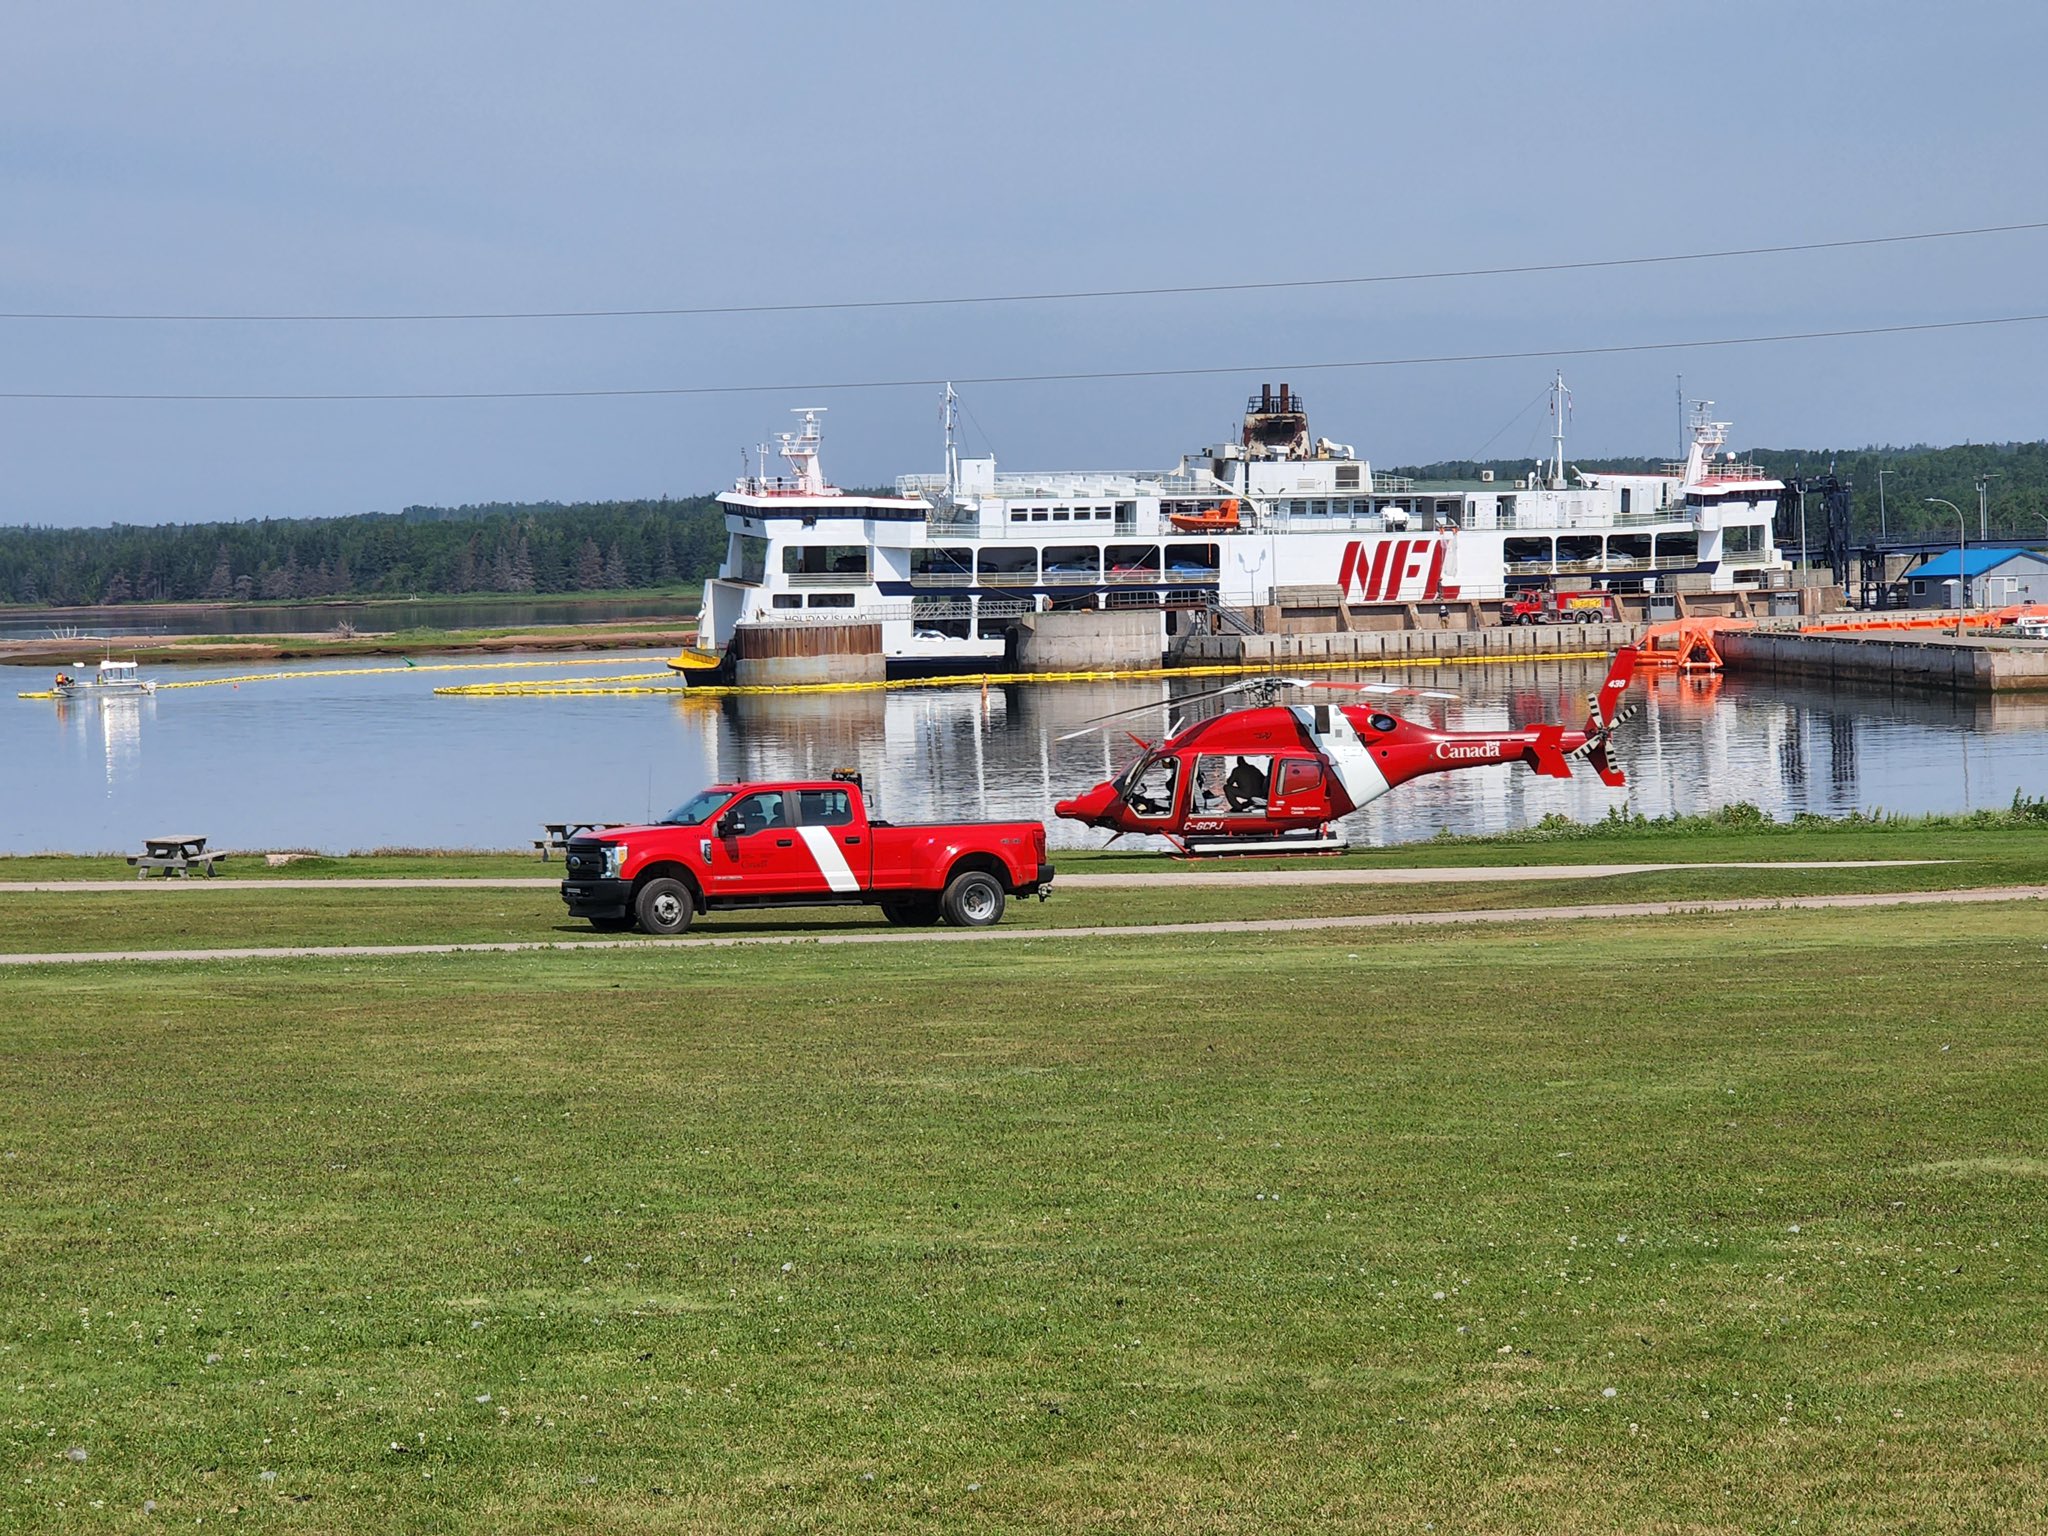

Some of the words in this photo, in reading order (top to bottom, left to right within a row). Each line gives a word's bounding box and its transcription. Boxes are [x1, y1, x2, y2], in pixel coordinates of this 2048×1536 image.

[1338, 540, 1461, 601] NFL
[1436, 741, 1501, 759] Canada
[1183, 821, 1224, 830] C-GCPJ
